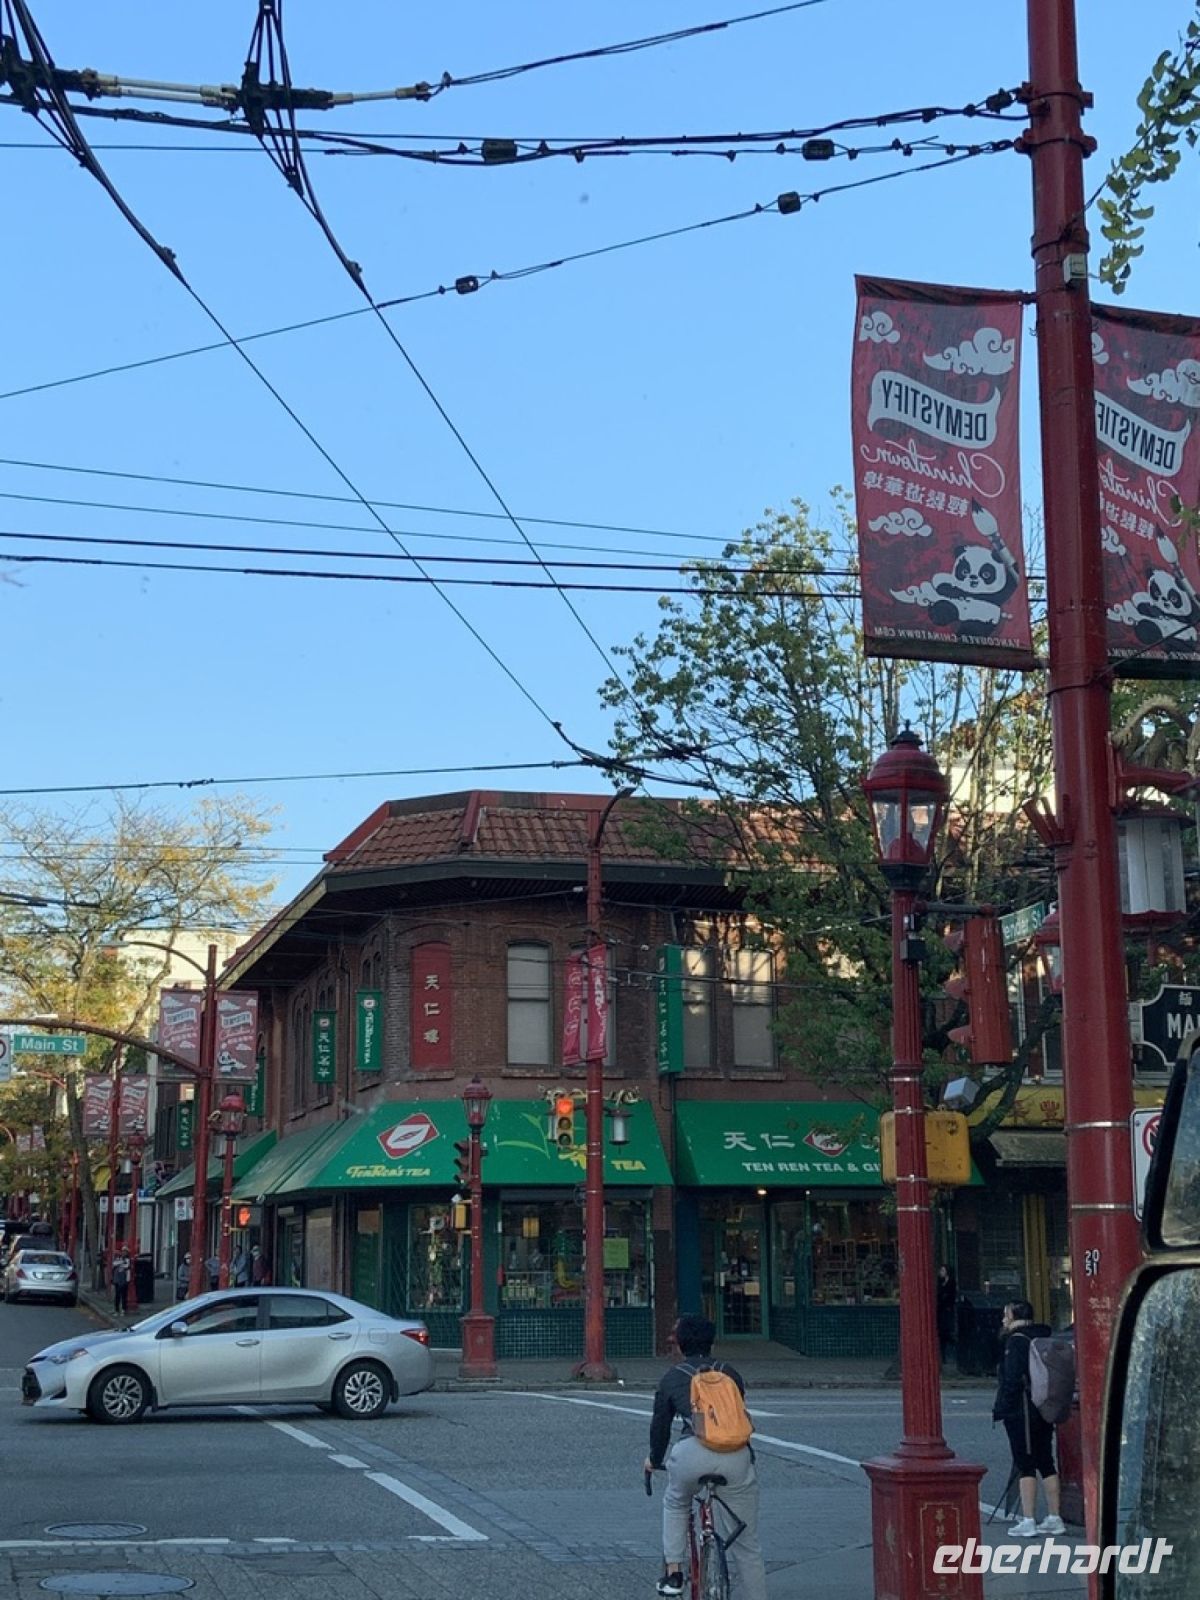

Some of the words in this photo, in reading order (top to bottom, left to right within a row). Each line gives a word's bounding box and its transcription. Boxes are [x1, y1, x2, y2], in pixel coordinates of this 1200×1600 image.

[1002, 918, 1029, 939] ender
[1167, 1013, 1200, 1039] MA
[21, 1037, 56, 1051] Main
[62, 1039, 78, 1051] St
[611, 1160, 646, 1171] TEA
[742, 1162, 774, 1172] TEN
[778, 1162, 810, 1173] REN
[813, 1163, 844, 1173] TEA
[847, 1163, 859, 1173] &
[862, 1163, 881, 1173] GI
